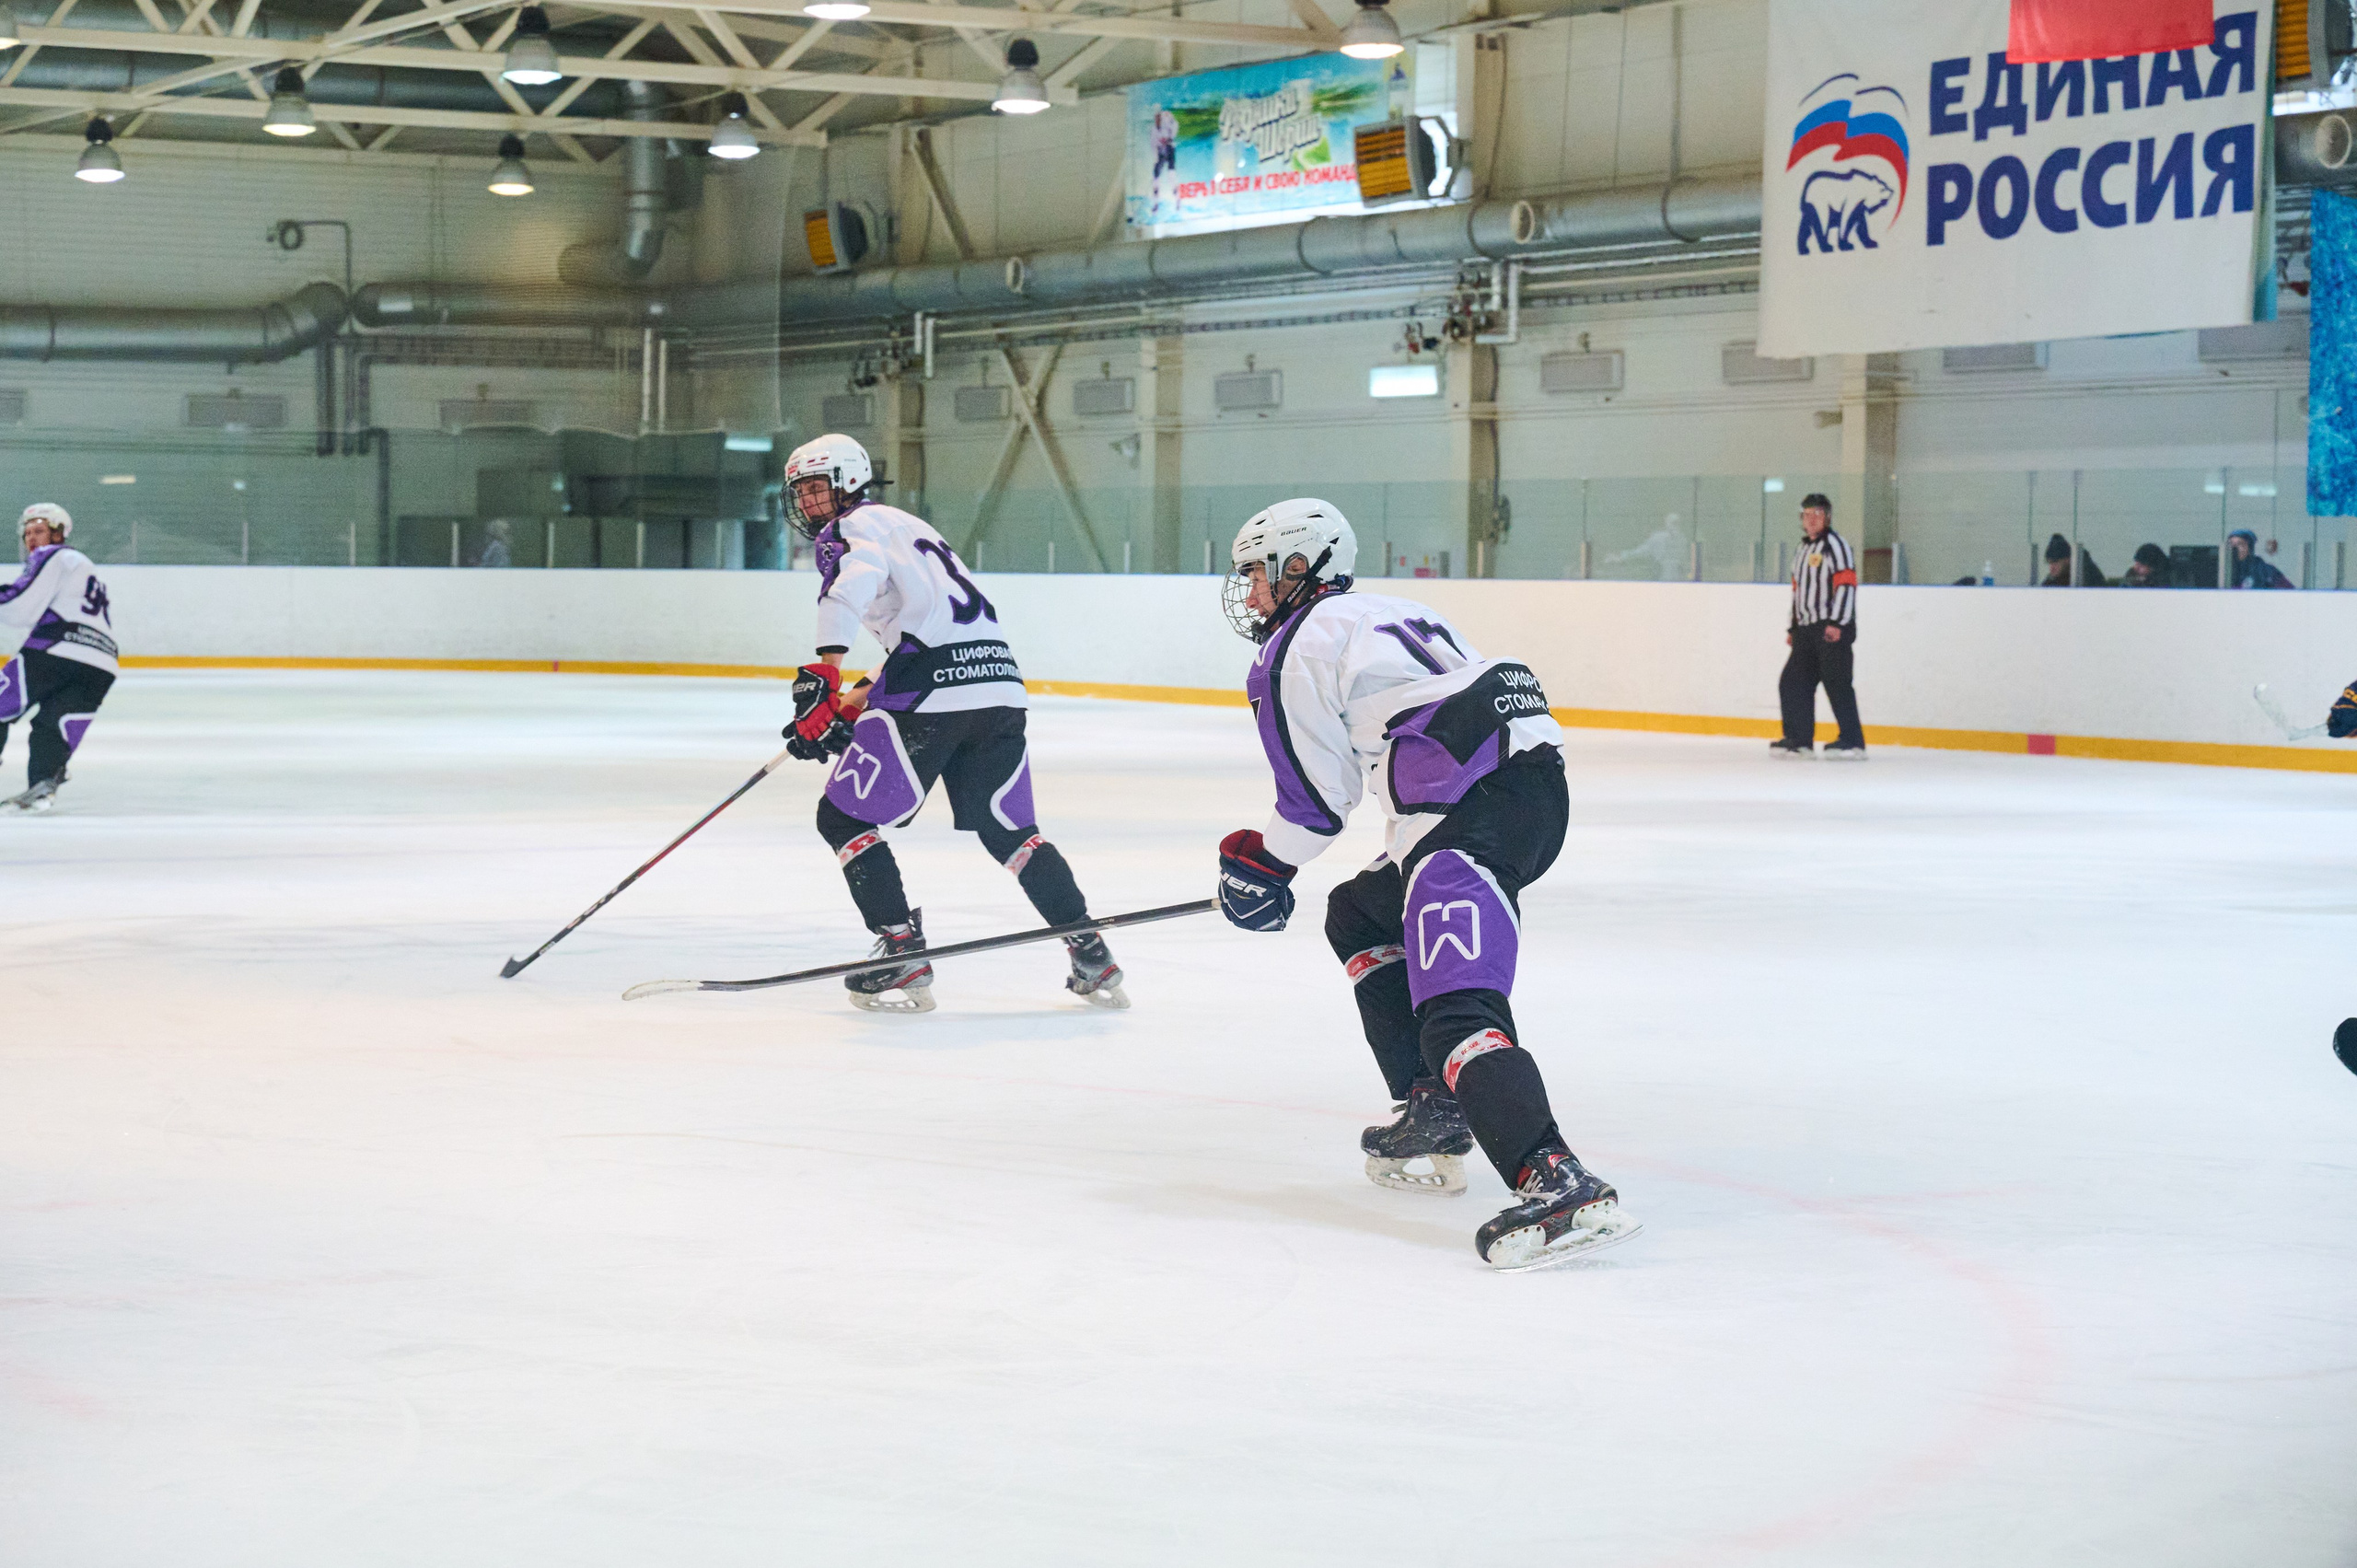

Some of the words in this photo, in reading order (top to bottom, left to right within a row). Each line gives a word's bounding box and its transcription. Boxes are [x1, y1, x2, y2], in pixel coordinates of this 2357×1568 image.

[1929, 10, 2258, 143] ЕДИНАЯ
[1219, 175, 1250, 194] СЕБЯ
[1253, 175, 1262, 192] И
[1265, 170, 1301, 190] СВОЮ
[1926, 123, 2255, 247] РОССИЯ
[1280, 526, 1307, 537] BAUER
